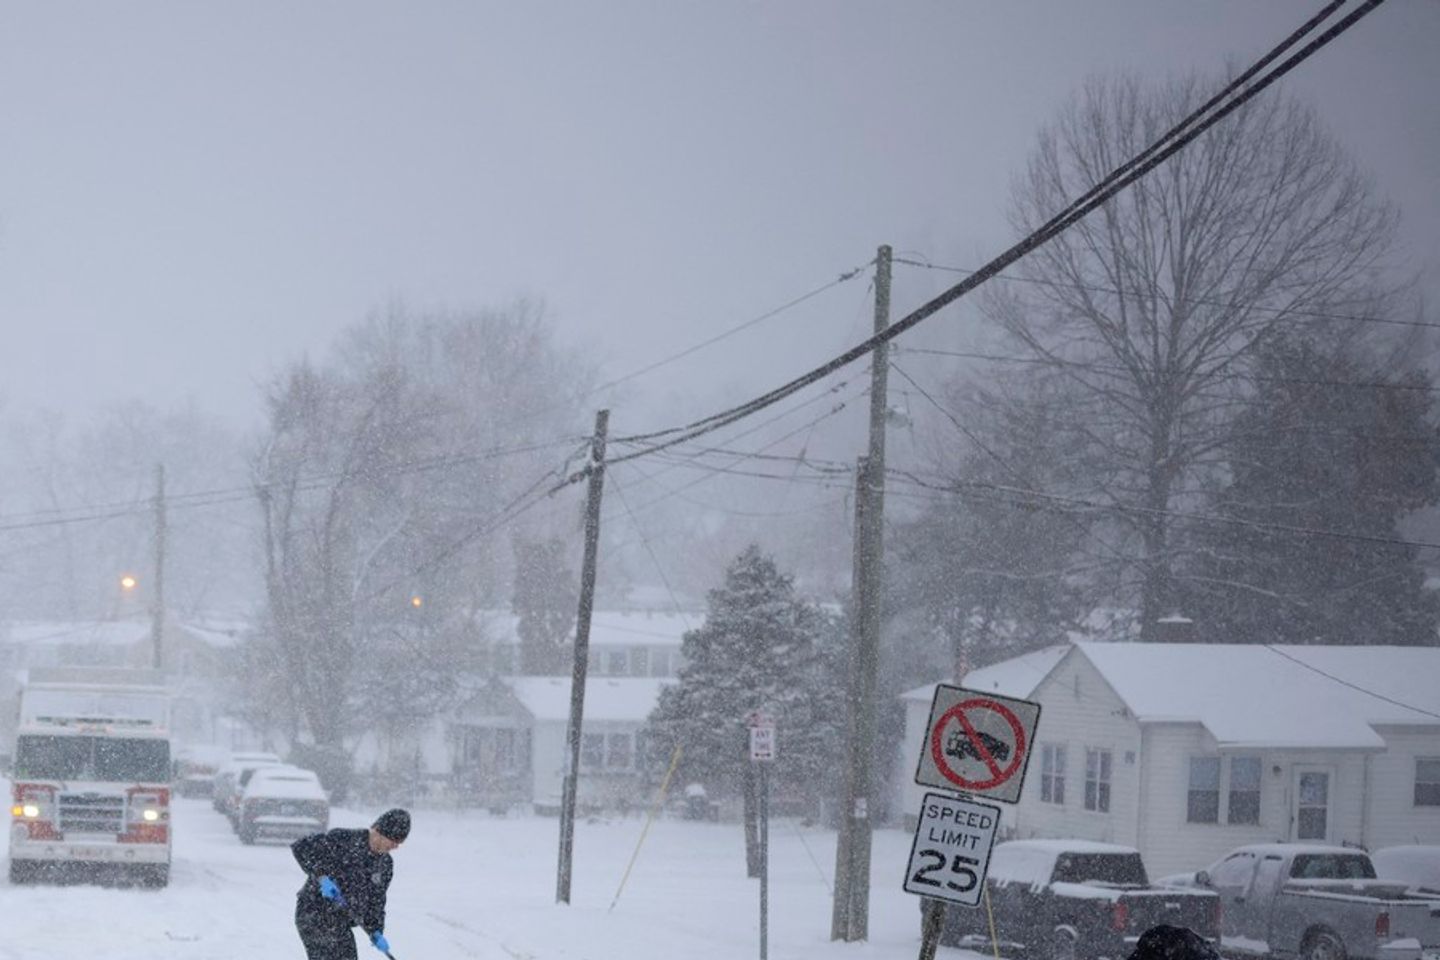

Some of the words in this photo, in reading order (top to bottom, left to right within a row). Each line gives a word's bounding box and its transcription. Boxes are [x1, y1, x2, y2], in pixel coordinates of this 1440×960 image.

[927, 805, 992, 830] SPEED
[928, 827, 981, 850] LIMIT
[912, 849, 980, 893] 25
